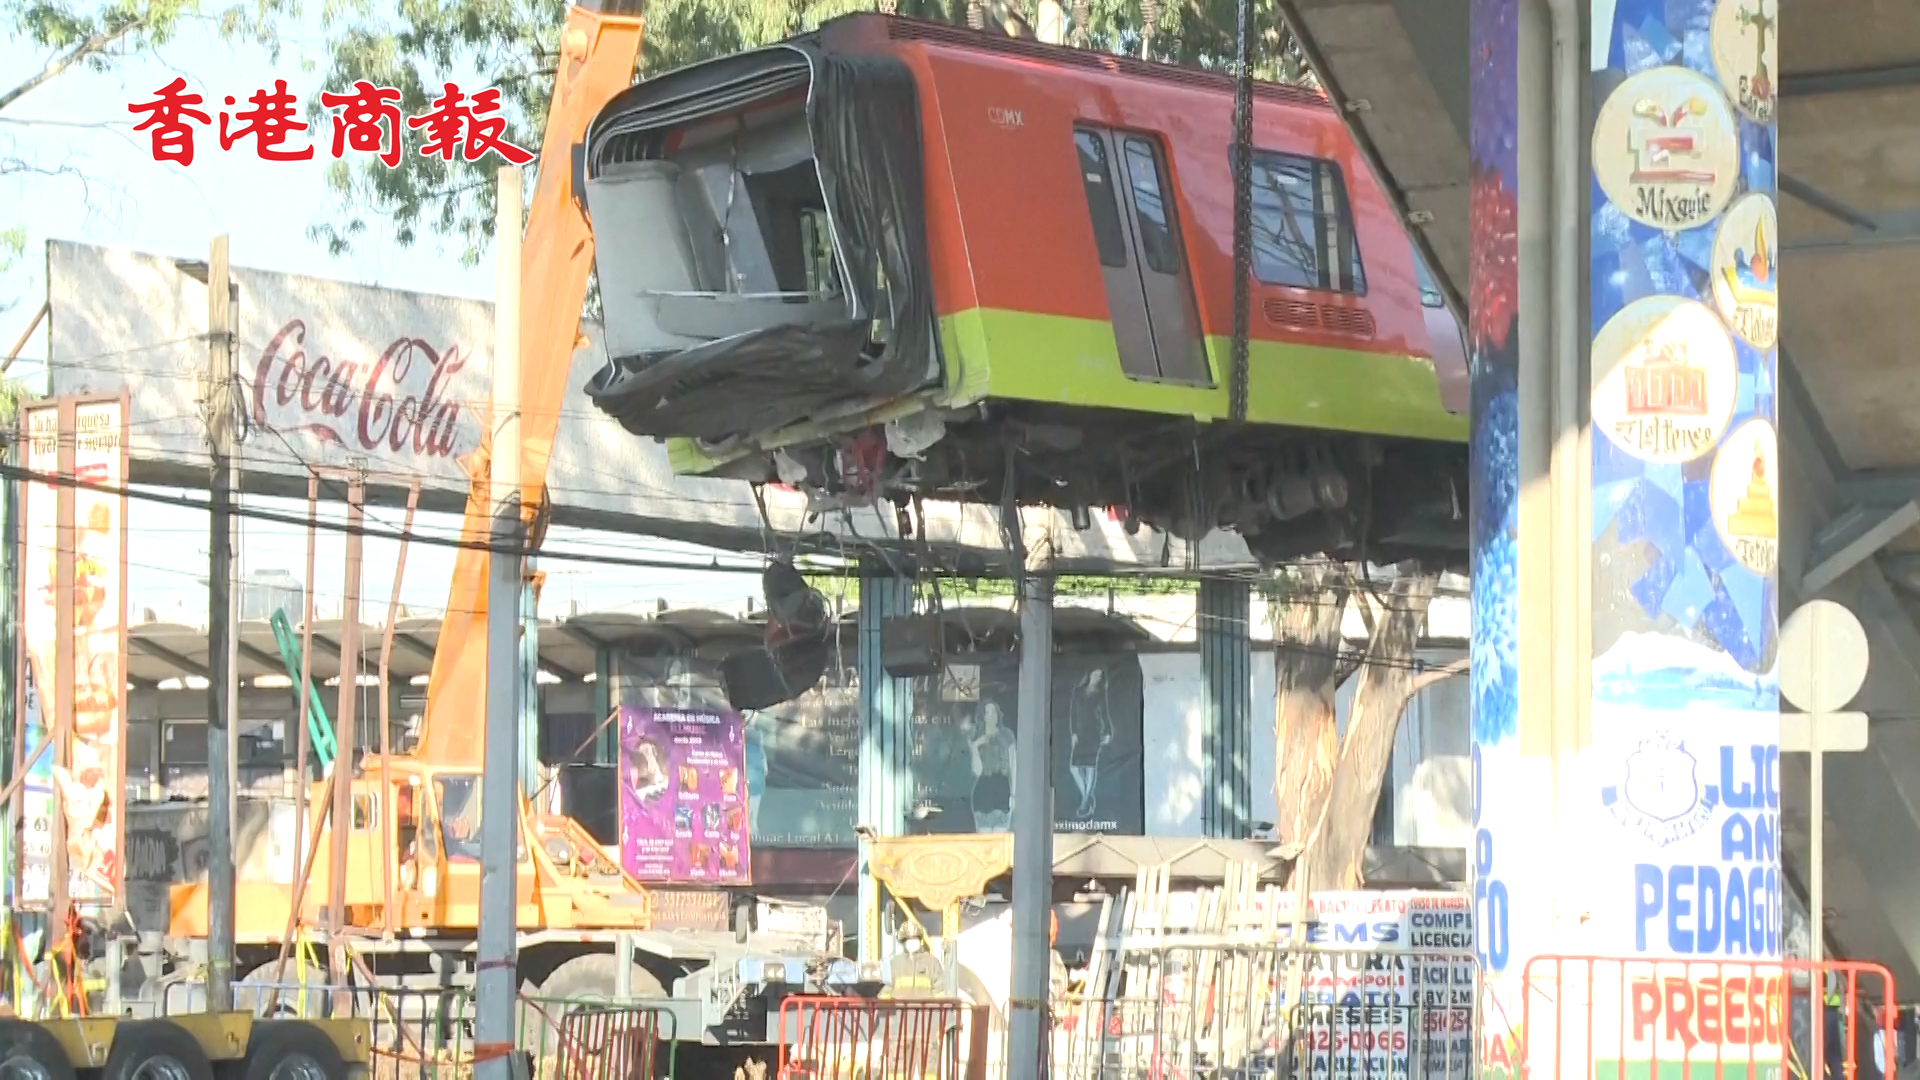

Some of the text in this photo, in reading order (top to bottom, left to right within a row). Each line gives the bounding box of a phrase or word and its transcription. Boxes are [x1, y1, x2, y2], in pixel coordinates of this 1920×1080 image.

[987, 107, 1024, 126] CDMX
[1720, 811, 1780, 862] AN
[1634, 863, 1781, 956] PEDAGO
